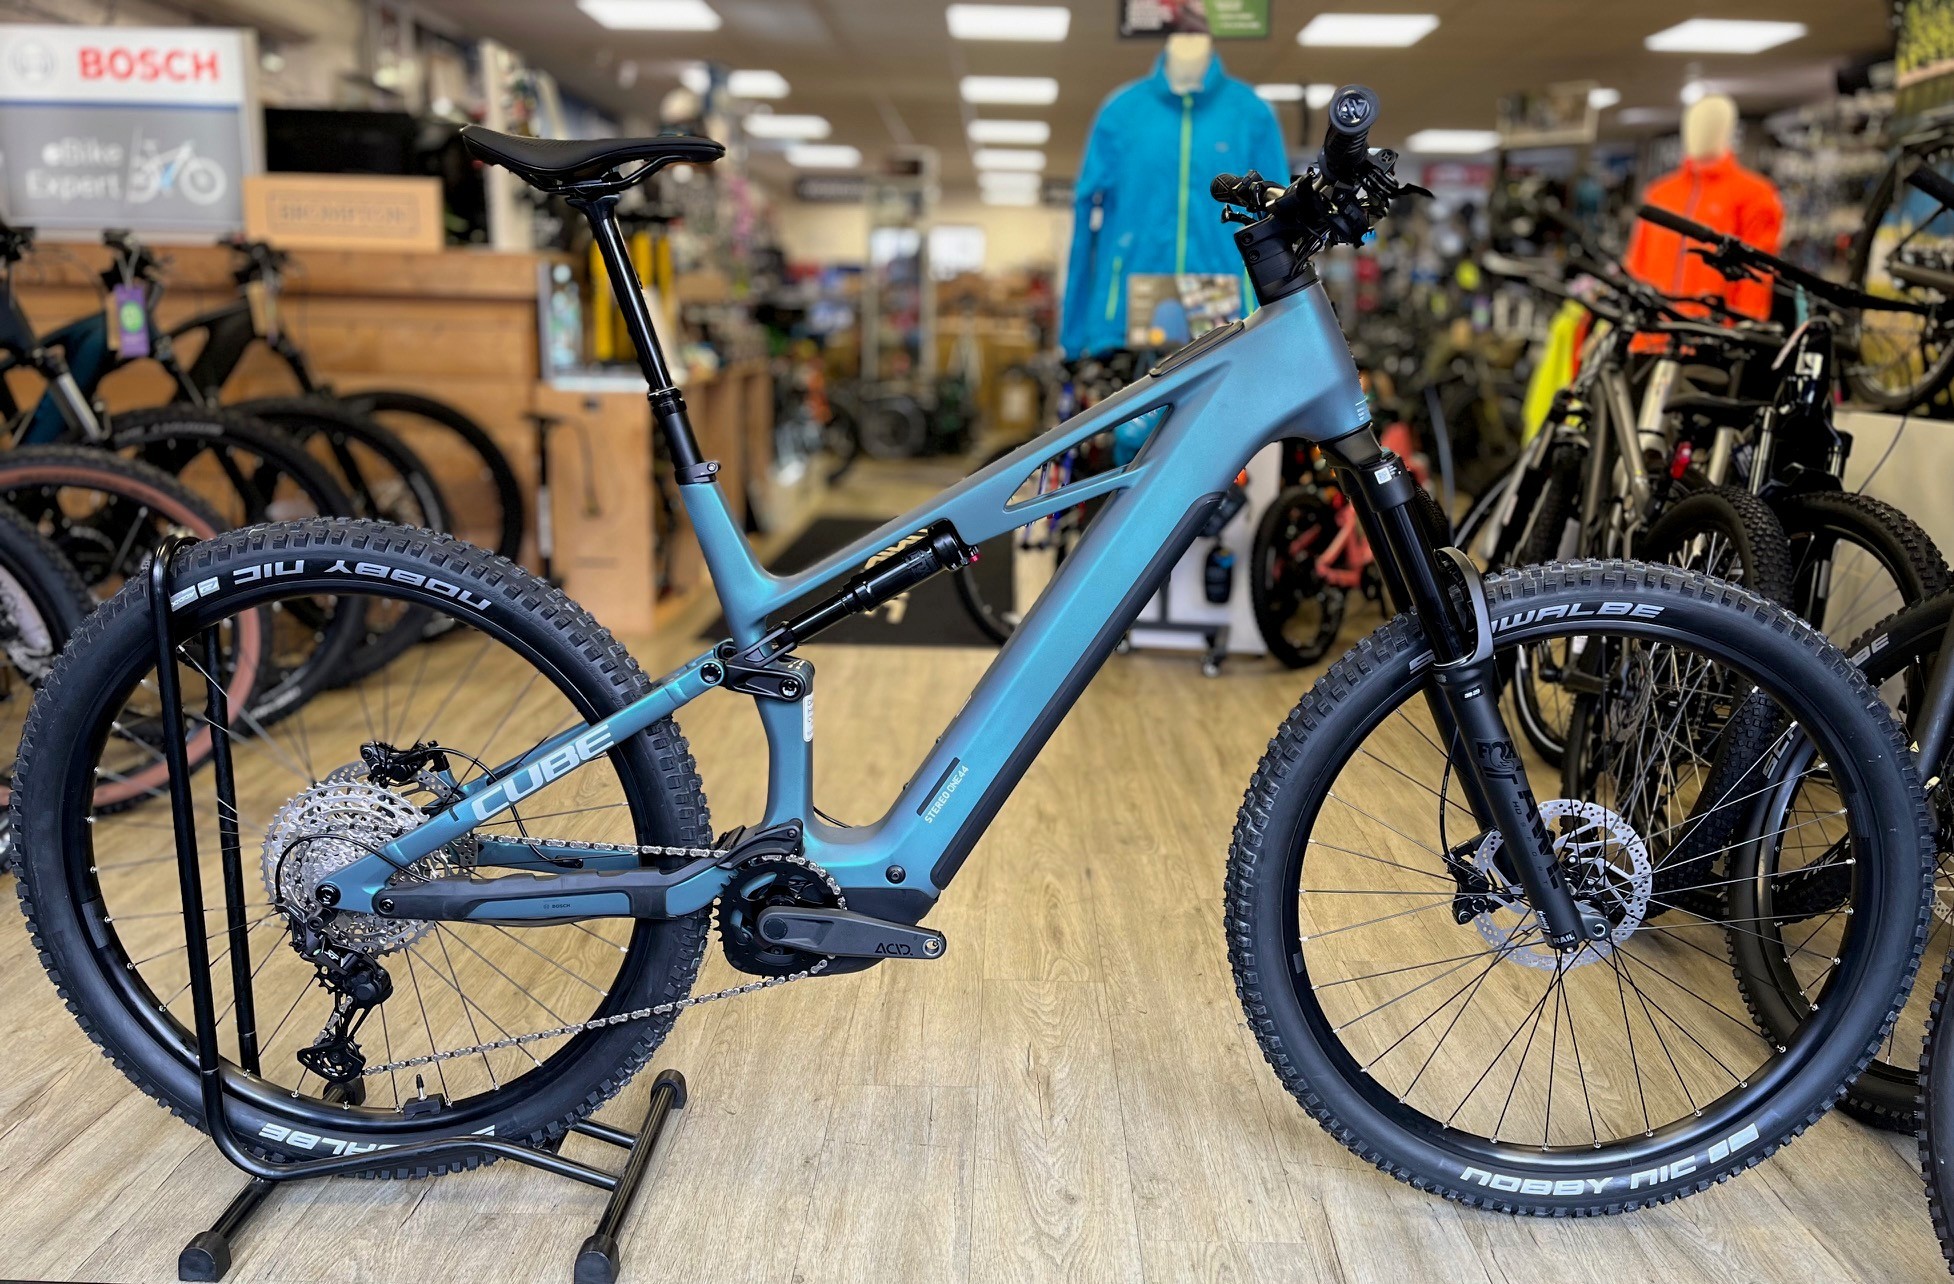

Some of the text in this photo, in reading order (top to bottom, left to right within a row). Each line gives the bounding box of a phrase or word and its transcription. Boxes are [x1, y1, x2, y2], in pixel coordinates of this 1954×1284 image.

[78, 47, 220, 82] BOSCH
[1409, 601, 1666, 675] SWALBE
[471, 724, 615, 821] CUBE
[924, 765, 970, 824] STEREO ONE44
